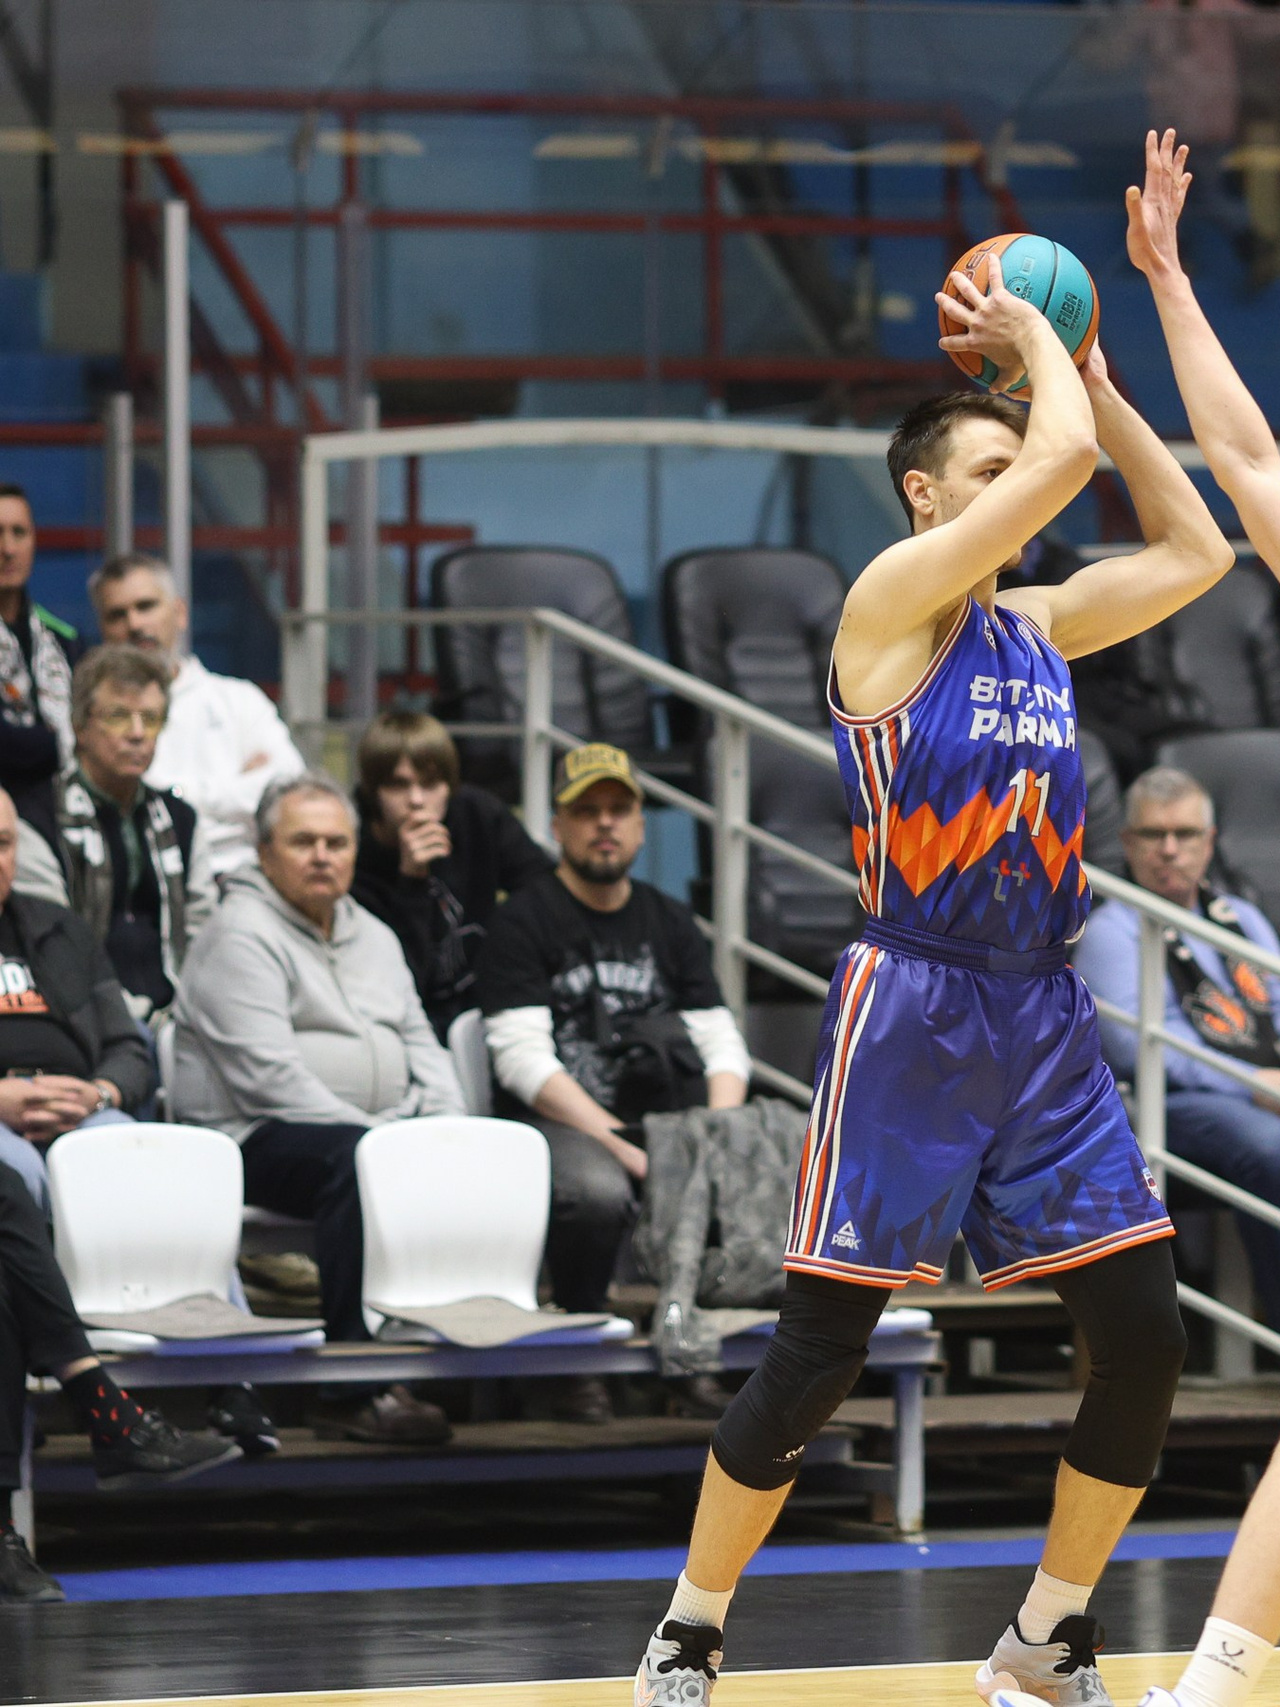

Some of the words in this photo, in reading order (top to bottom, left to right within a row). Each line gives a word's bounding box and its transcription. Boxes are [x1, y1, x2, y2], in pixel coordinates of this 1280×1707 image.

[1056, 291, 1078, 328] FIBA
[968, 707, 1076, 752] PARMA
[1004, 768, 1051, 837] 11
[831, 1233, 862, 1251] PEAK
